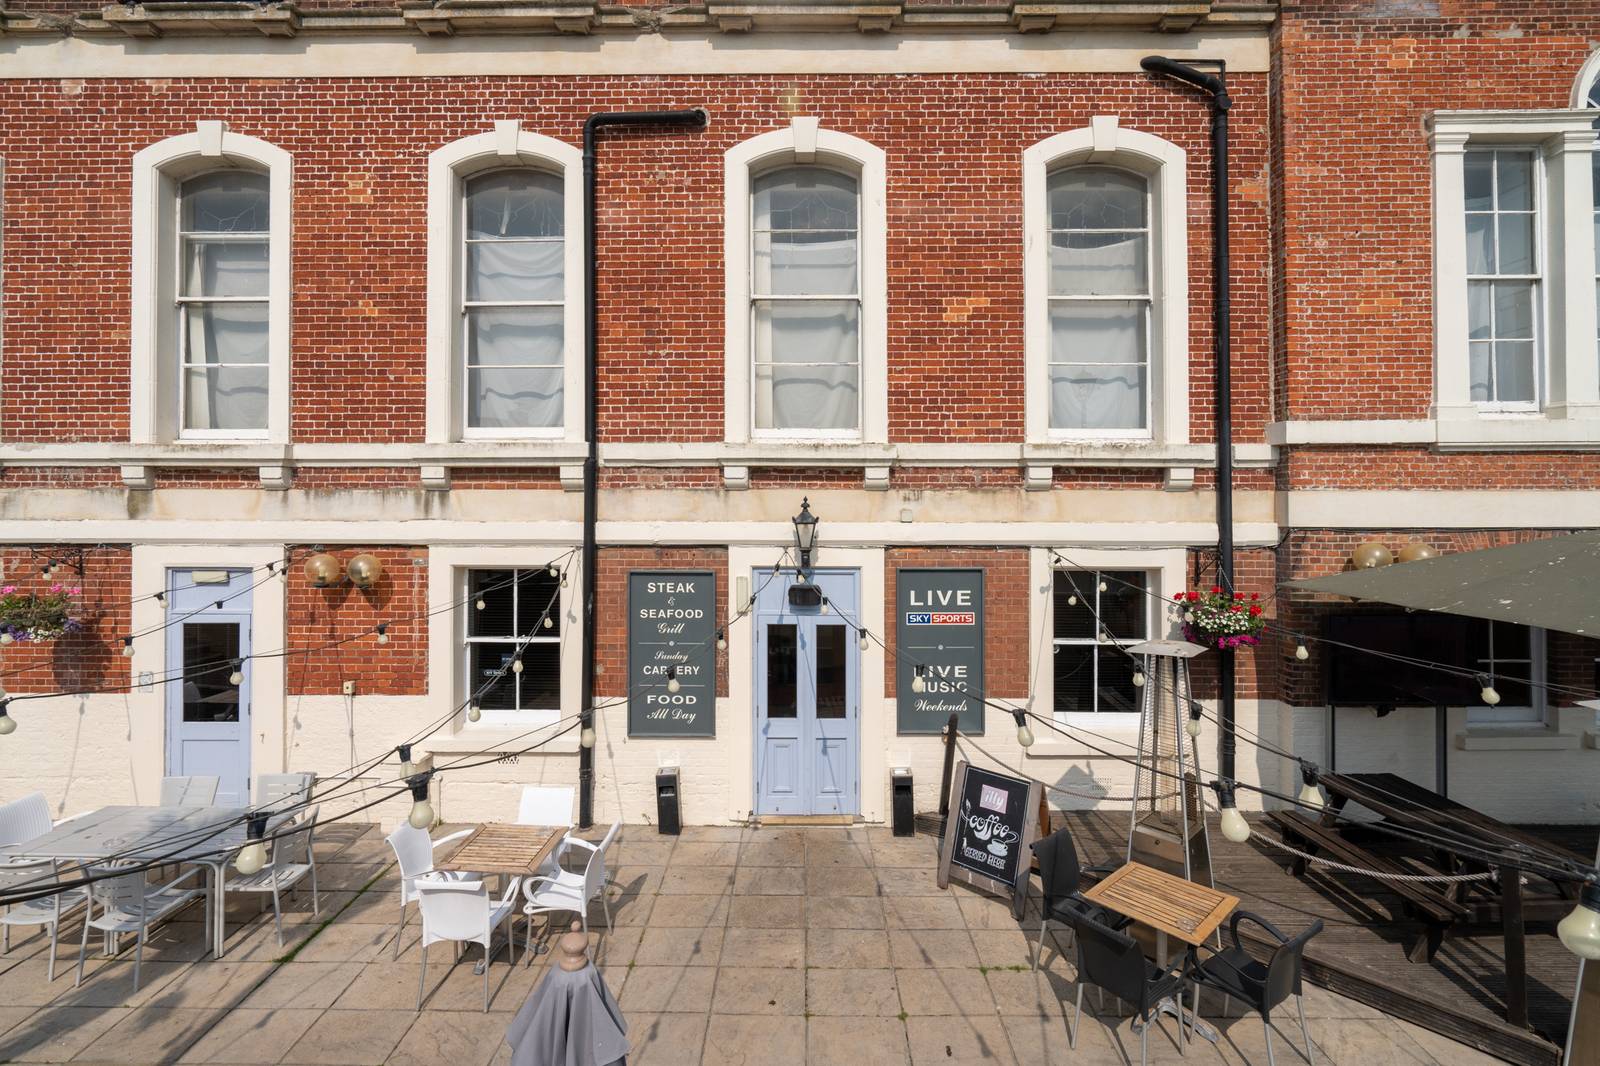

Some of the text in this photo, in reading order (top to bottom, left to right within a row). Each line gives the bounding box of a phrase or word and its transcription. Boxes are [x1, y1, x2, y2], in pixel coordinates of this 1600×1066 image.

[647, 582, 696, 593] STEAK
[667, 596, 676, 606] &
[910, 590, 972, 606] LIVE
[640, 609, 704, 619] SEAFOOD
[909, 614, 973, 623] SKY SPORTS
[657, 622, 685, 634] Grill
[654, 650, 689, 663] Sunday
[643, 665, 700, 675] CARERY
[914, 681, 968, 693] USIC
[647, 695, 697, 705] FOOD
[914, 699, 968, 712] Weekends
[646, 708, 696, 724] All Day
[985, 791, 1004, 809] illy
[969, 814, 1009, 840] coffee
